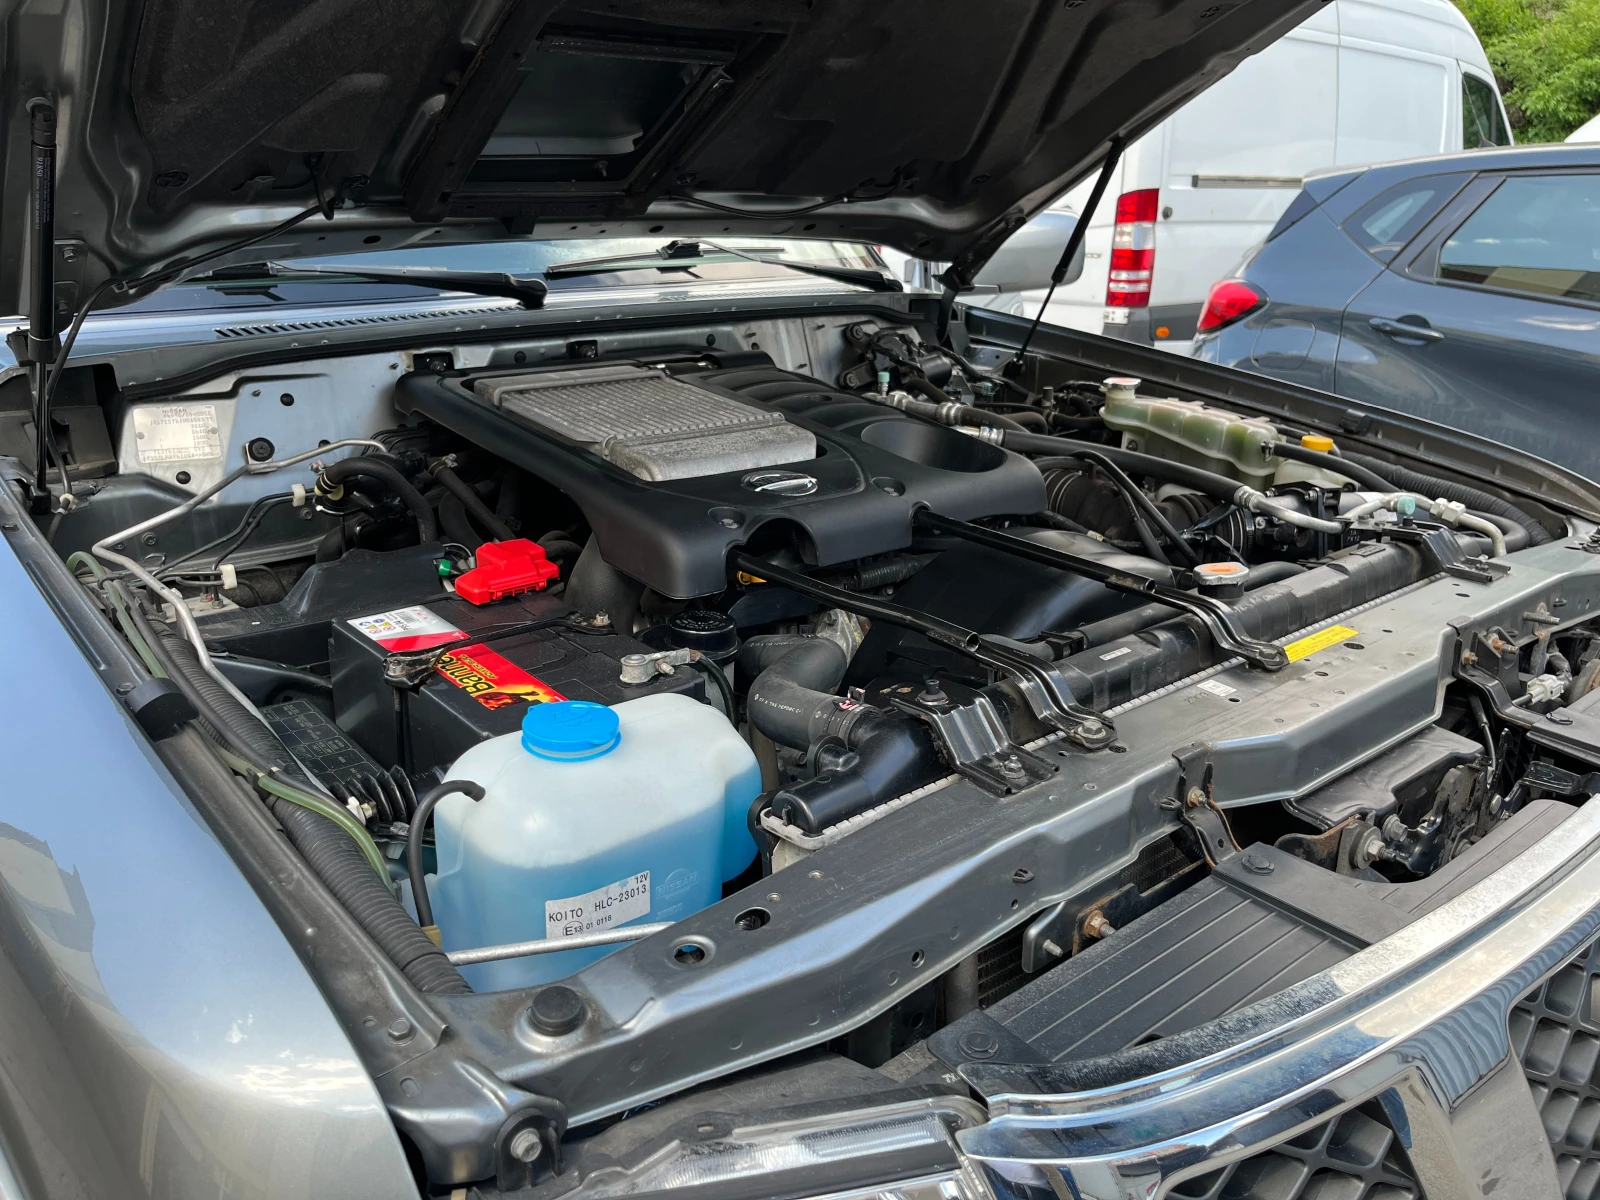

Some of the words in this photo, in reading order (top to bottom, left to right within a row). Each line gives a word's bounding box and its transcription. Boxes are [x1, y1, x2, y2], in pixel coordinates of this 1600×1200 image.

[437, 653, 496, 694] Banne
[635, 872, 649, 885] 12V
[657, 873, 698, 898] NISSAN
[548, 907, 584, 923] KOITO
[594, 884, 647, 912] HLC-23013
[585, 922, 594, 930] 01
[596, 914, 612, 926] 0118
